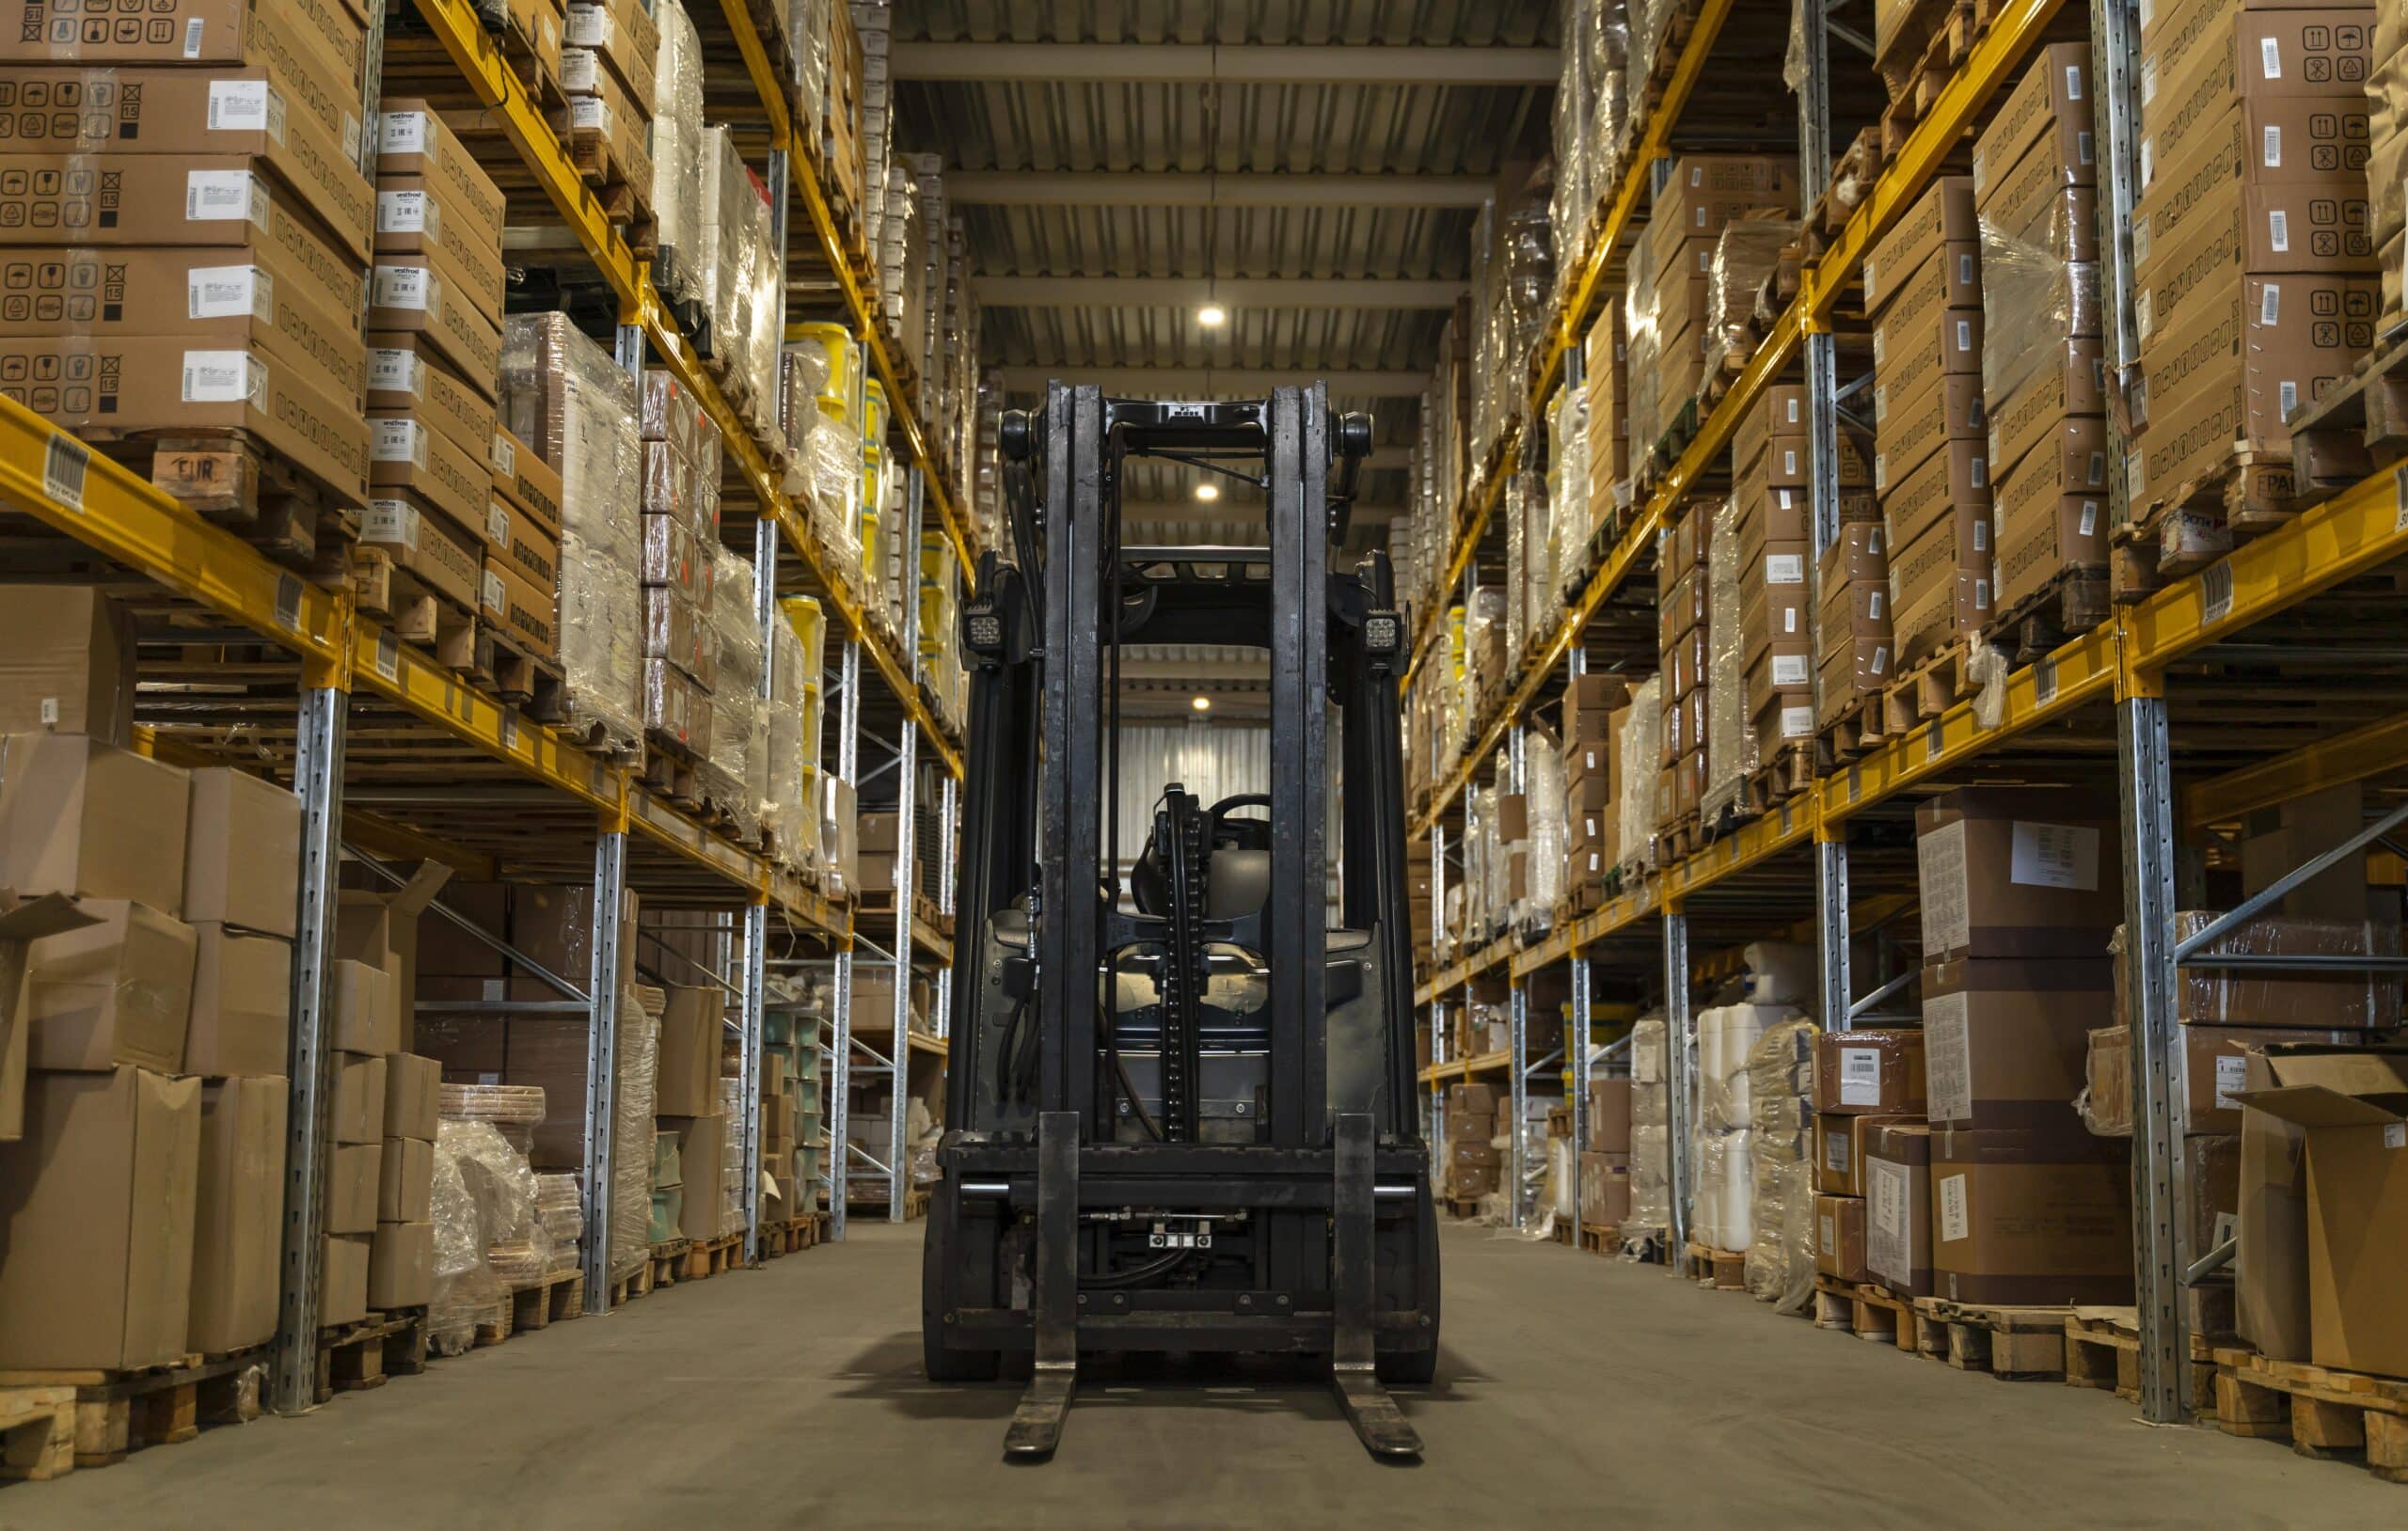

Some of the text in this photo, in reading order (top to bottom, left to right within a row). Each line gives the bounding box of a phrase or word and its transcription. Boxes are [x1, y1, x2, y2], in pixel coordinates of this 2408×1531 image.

[123, 106, 137, 117] 15
[104, 195, 117, 204] 15
[108, 288, 121, 298] 15
[103, 379, 117, 389] 15
